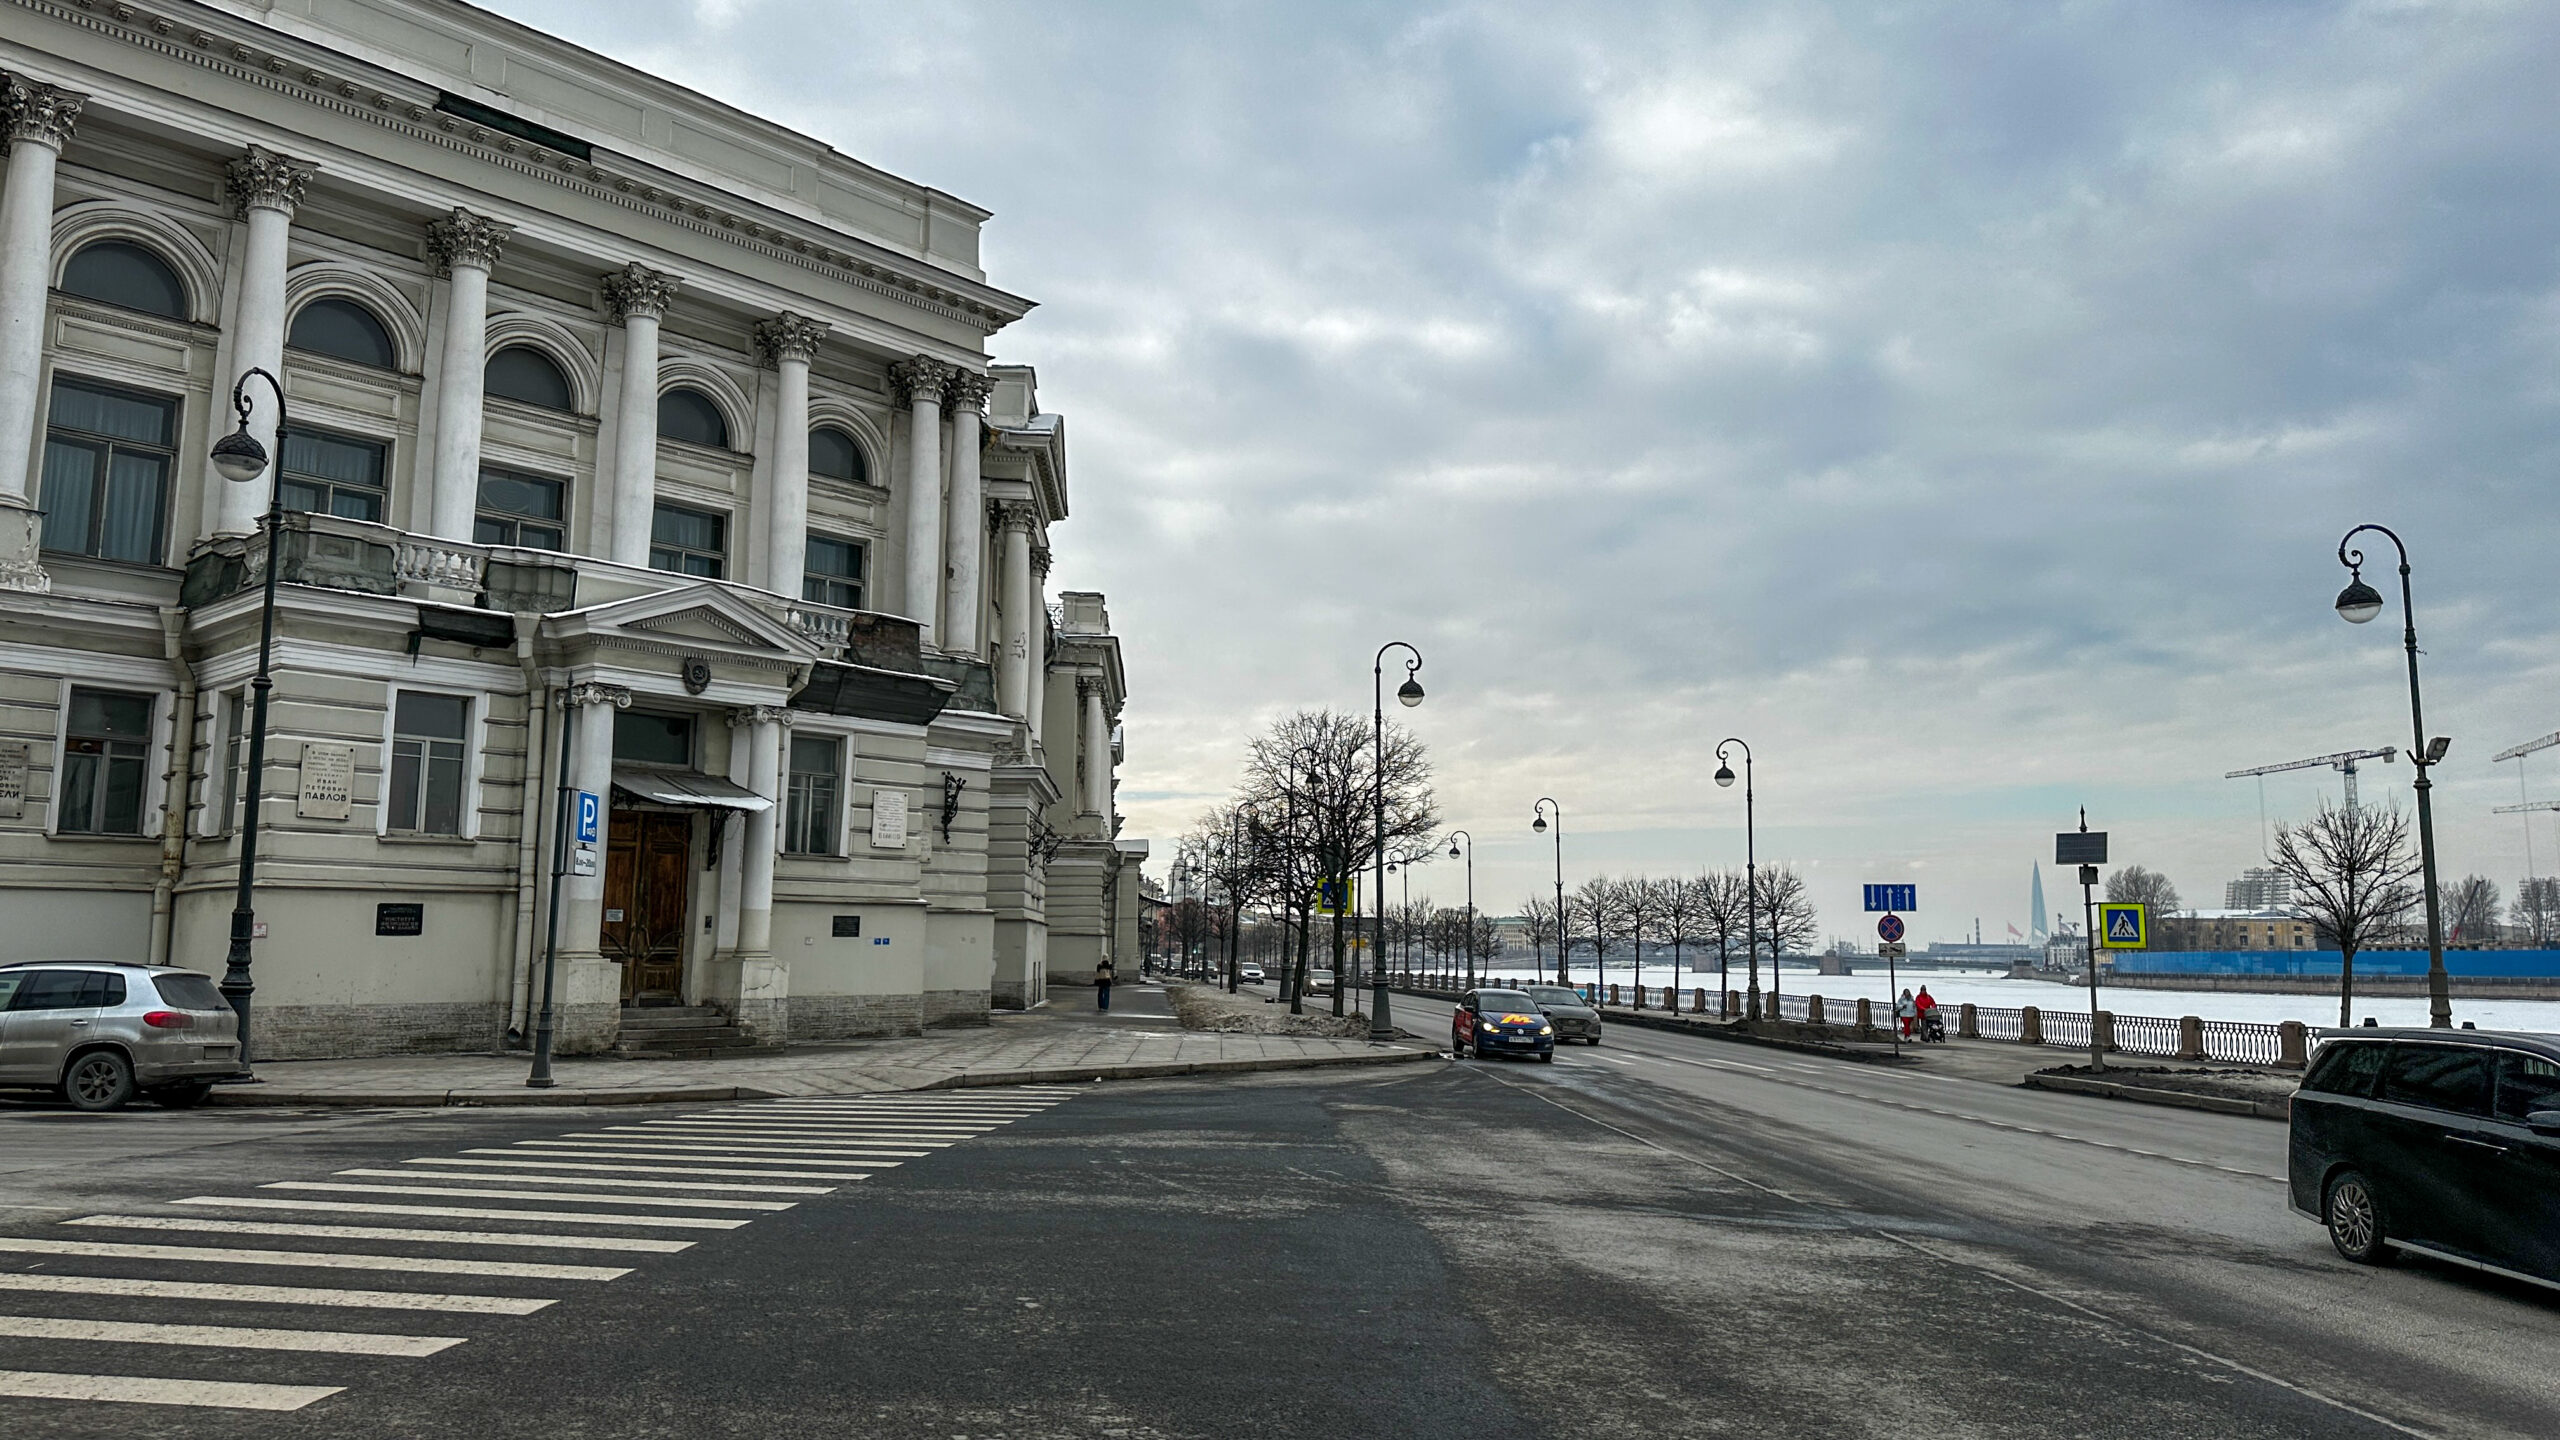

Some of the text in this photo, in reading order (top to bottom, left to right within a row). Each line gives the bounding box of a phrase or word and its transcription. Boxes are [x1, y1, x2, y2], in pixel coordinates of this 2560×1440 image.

[305, 784, 348, 792] ПЕТРОВИЧ
[304, 791, 347, 802] ПАВЛОВ
[582, 797, 596, 837] P
